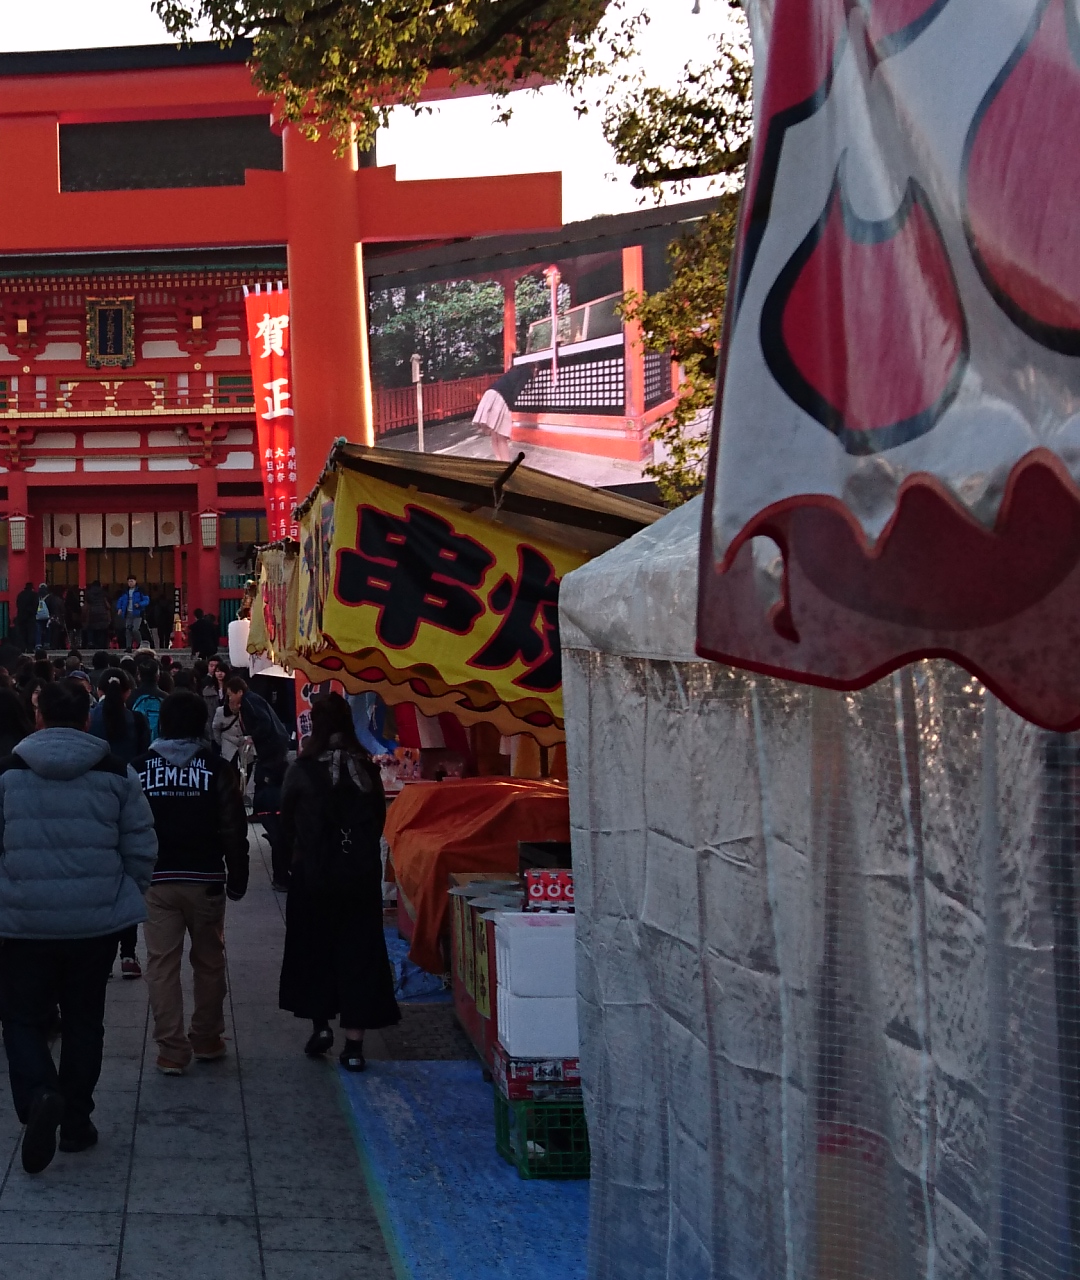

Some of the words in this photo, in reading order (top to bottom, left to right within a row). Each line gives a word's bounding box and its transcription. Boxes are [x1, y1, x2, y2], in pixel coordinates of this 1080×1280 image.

[255, 313, 294, 420] 賀正
[274, 447, 285, 483] 大山祭
[145, 757, 163, 769] THE
[138, 766, 213, 791] ELEMENT
[535, 1065, 562, 1078] Asahi
